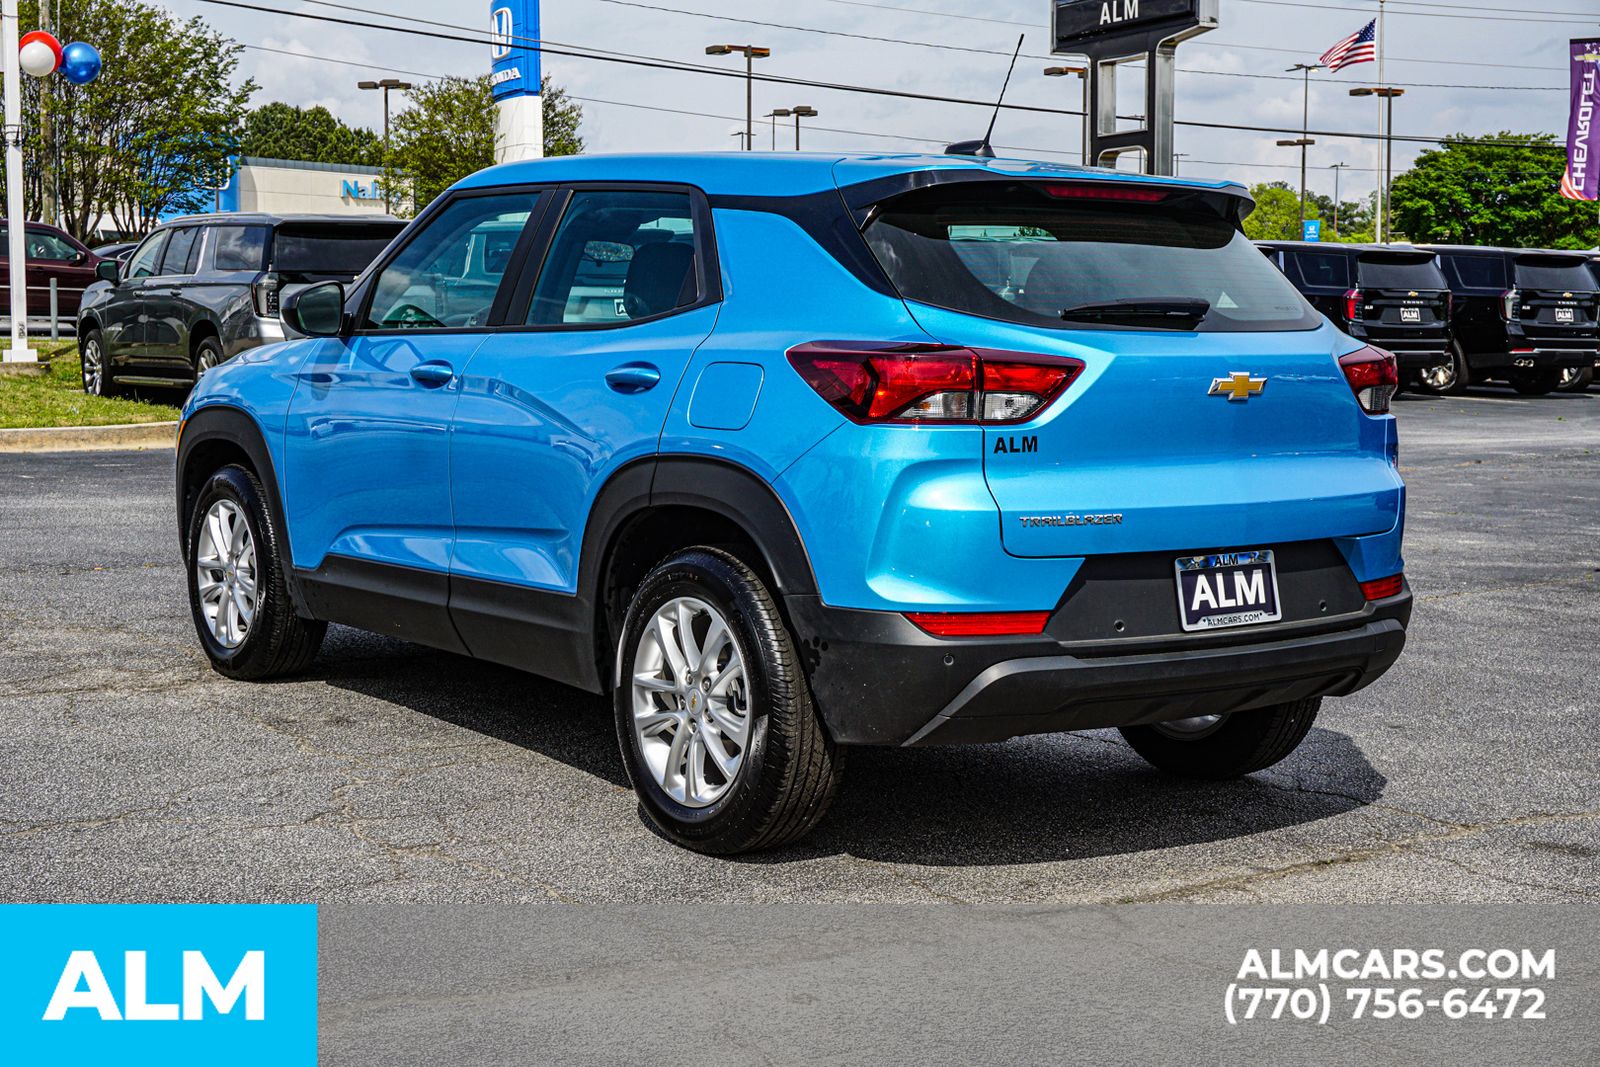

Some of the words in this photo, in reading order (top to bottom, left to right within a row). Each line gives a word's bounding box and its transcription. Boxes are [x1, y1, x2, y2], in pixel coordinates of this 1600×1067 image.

[1099, 0, 1139, 25] ALM
[1402, 311, 1418, 319] ALM
[1557, 311, 1571, 319] ALM
[993, 436, 1038, 454] ALM
[1019, 513, 1123, 528] TRAILBLAZER
[1215, 553, 1239, 567] ALM
[1191, 569, 1266, 611] ALM
[1207, 612, 1260, 627] ALMCARS.COM
